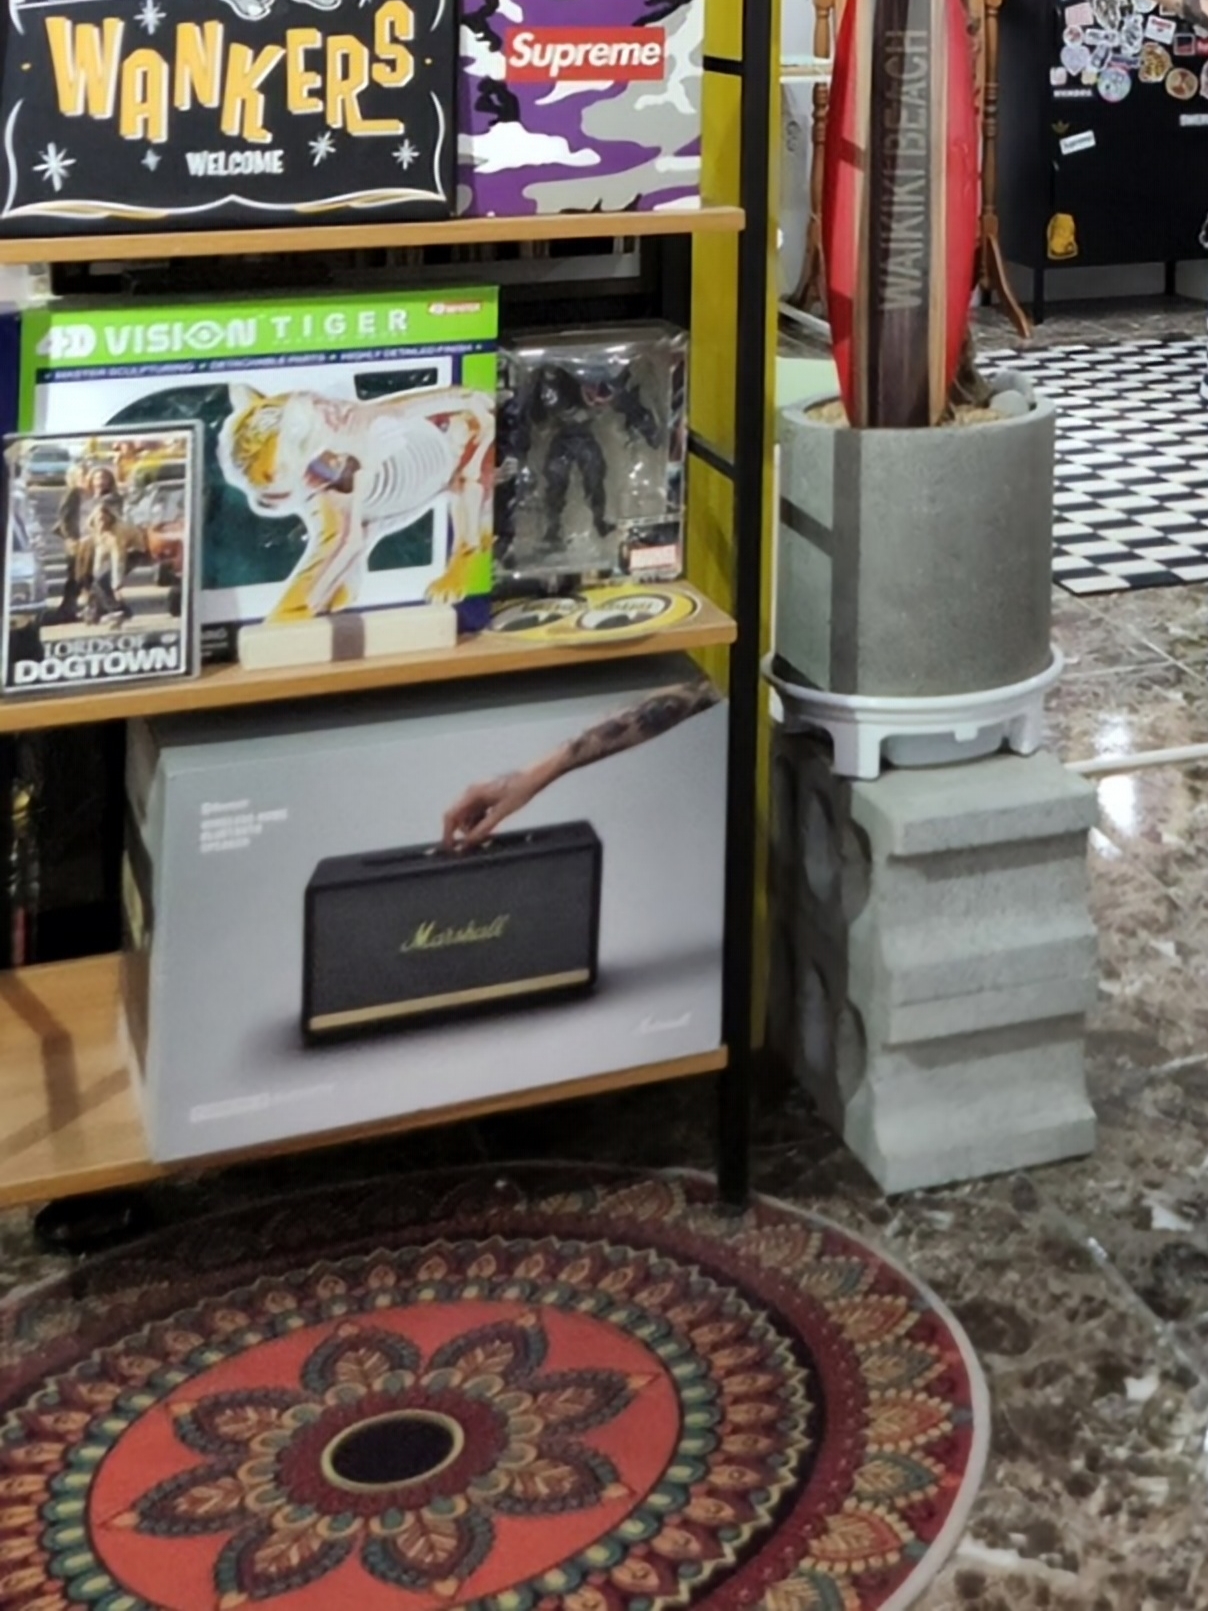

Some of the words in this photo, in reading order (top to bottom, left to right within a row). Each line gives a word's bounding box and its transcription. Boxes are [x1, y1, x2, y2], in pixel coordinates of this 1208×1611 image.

[509, 32, 662, 78] Supreme
[884, 29, 929, 156] BEACH
[185, 149, 284, 176] WELCOME
[879, 167, 926, 311] WAIKIKI
[104, 318, 258, 356] VISION
[271, 309, 408, 339] TIGER
[14, 646, 178, 684] DOGTOWN
[43, 639, 114, 659] LORDS
[117, 634, 147, 650] OF
[400, 914, 511, 952] Marshall
